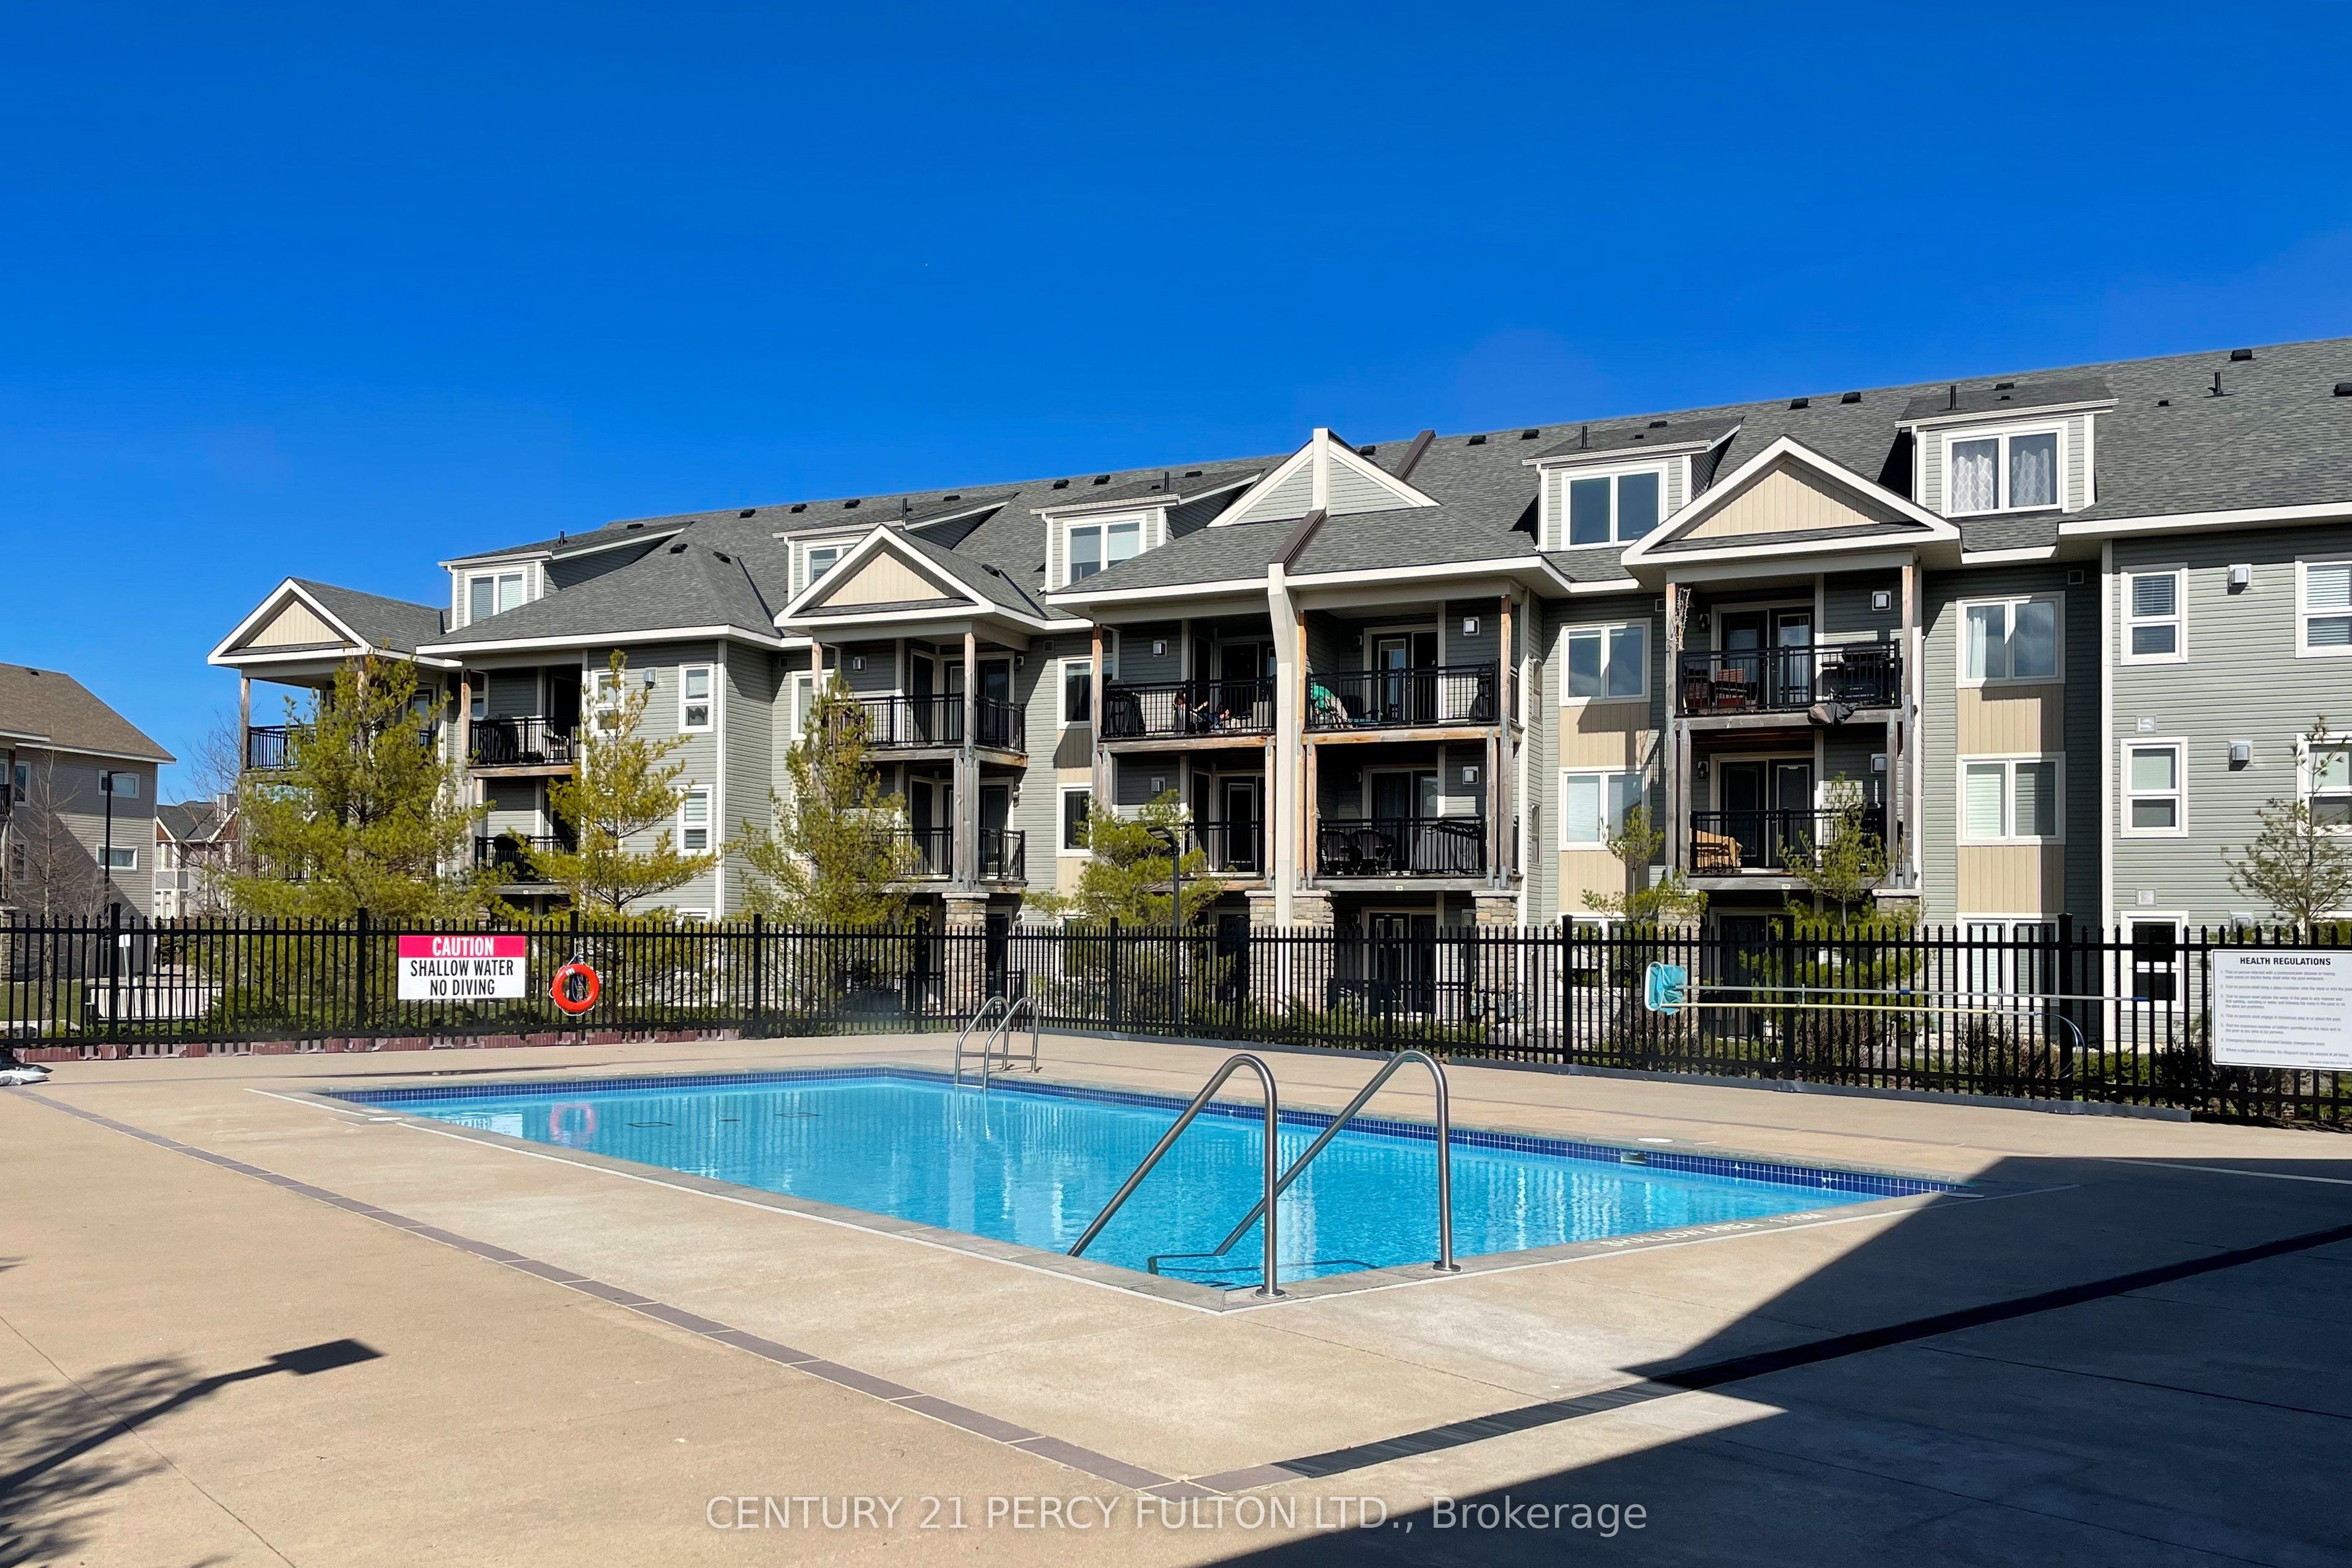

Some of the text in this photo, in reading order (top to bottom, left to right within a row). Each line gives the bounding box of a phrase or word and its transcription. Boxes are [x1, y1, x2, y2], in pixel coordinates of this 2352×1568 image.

[432, 937, 494, 956] CAUTION
[411, 960, 513, 977] SHALLOW WATER
[2240, 957, 2270, 965] HEALTH
[430, 979, 495, 996] NO DIVING
[1600, 1229, 1706, 1247] SHALLOW
[1703, 1222, 1765, 1233] AREA
